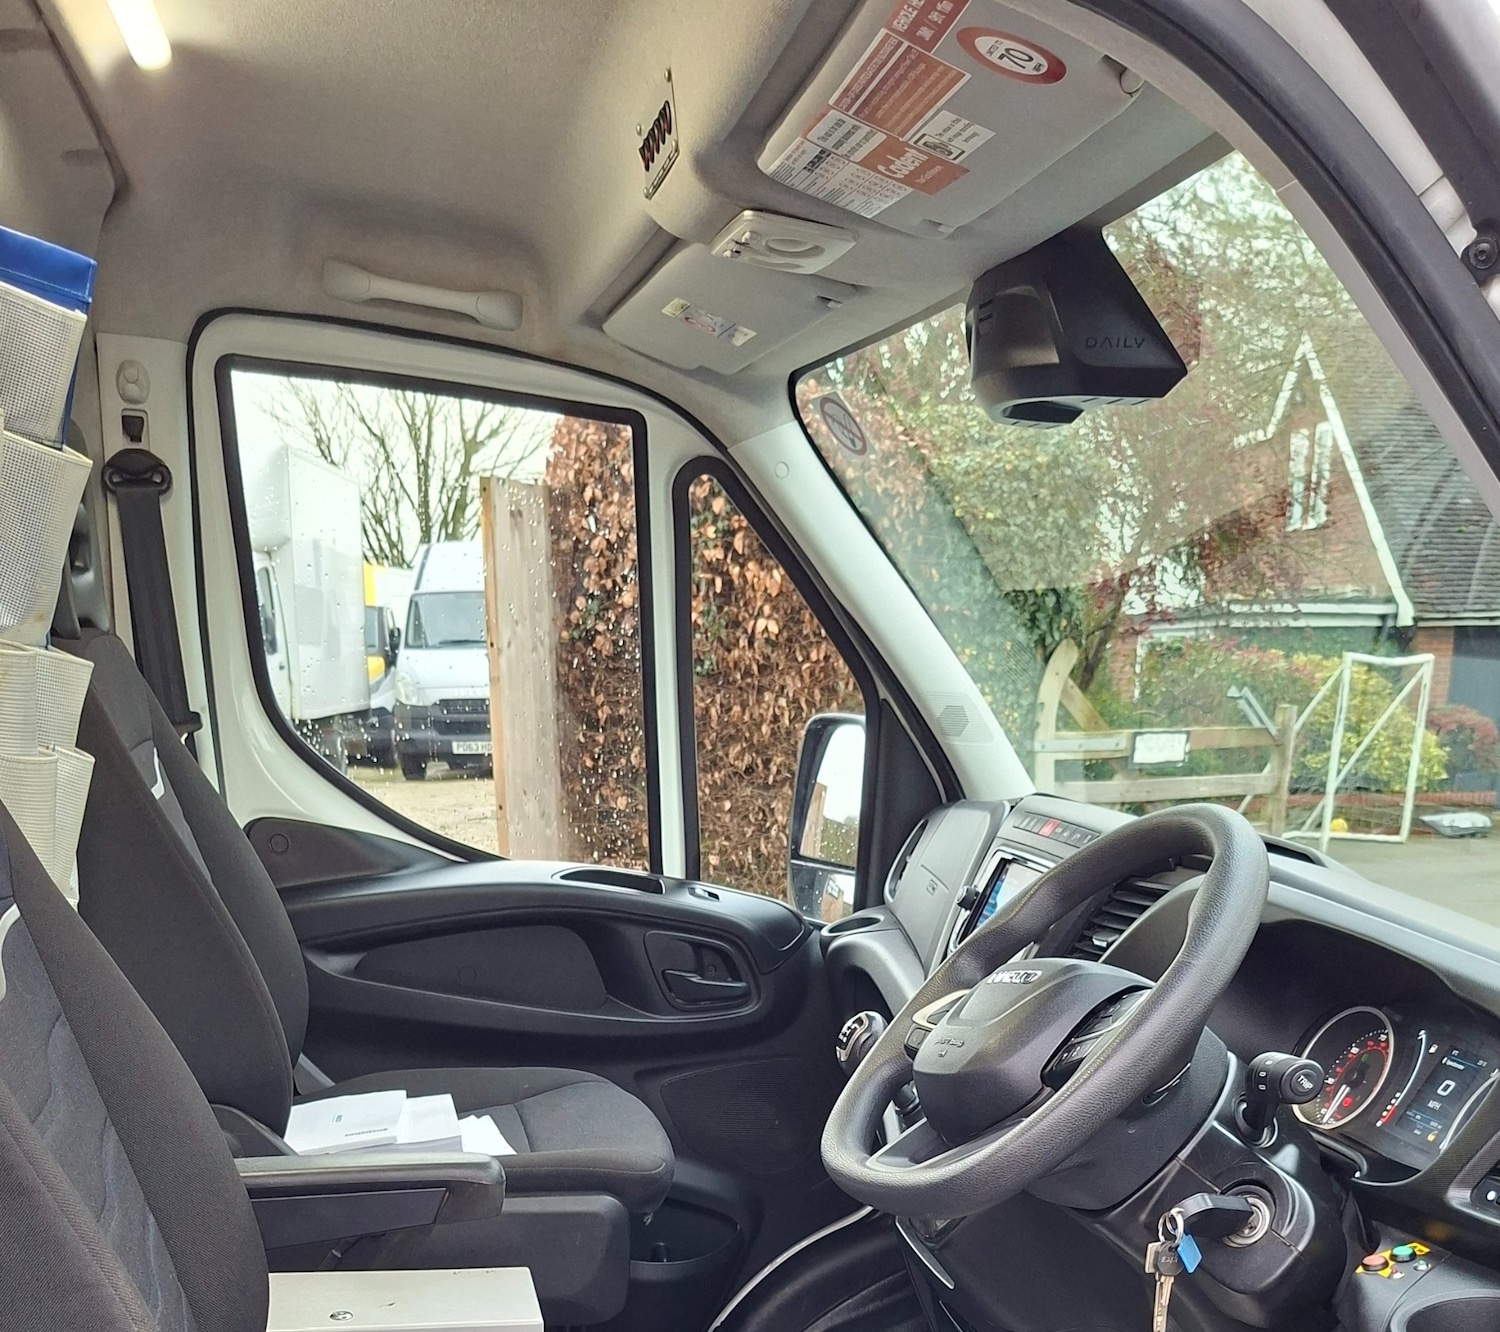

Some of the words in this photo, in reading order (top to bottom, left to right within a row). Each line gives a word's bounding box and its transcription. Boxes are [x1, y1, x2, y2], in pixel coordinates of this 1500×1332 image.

[998, 48, 1034, 69] 70
[876, 147, 930, 179] Cadent
[1085, 336, 1145, 348] DAILY
[456, 743, 479, 752] PO63
[481, 743, 493, 752] HD
[1297, 1075, 1313, 1090] TRIP
[1436, 1079, 1456, 1097] 0
[1427, 1099, 1442, 1111] MPH
